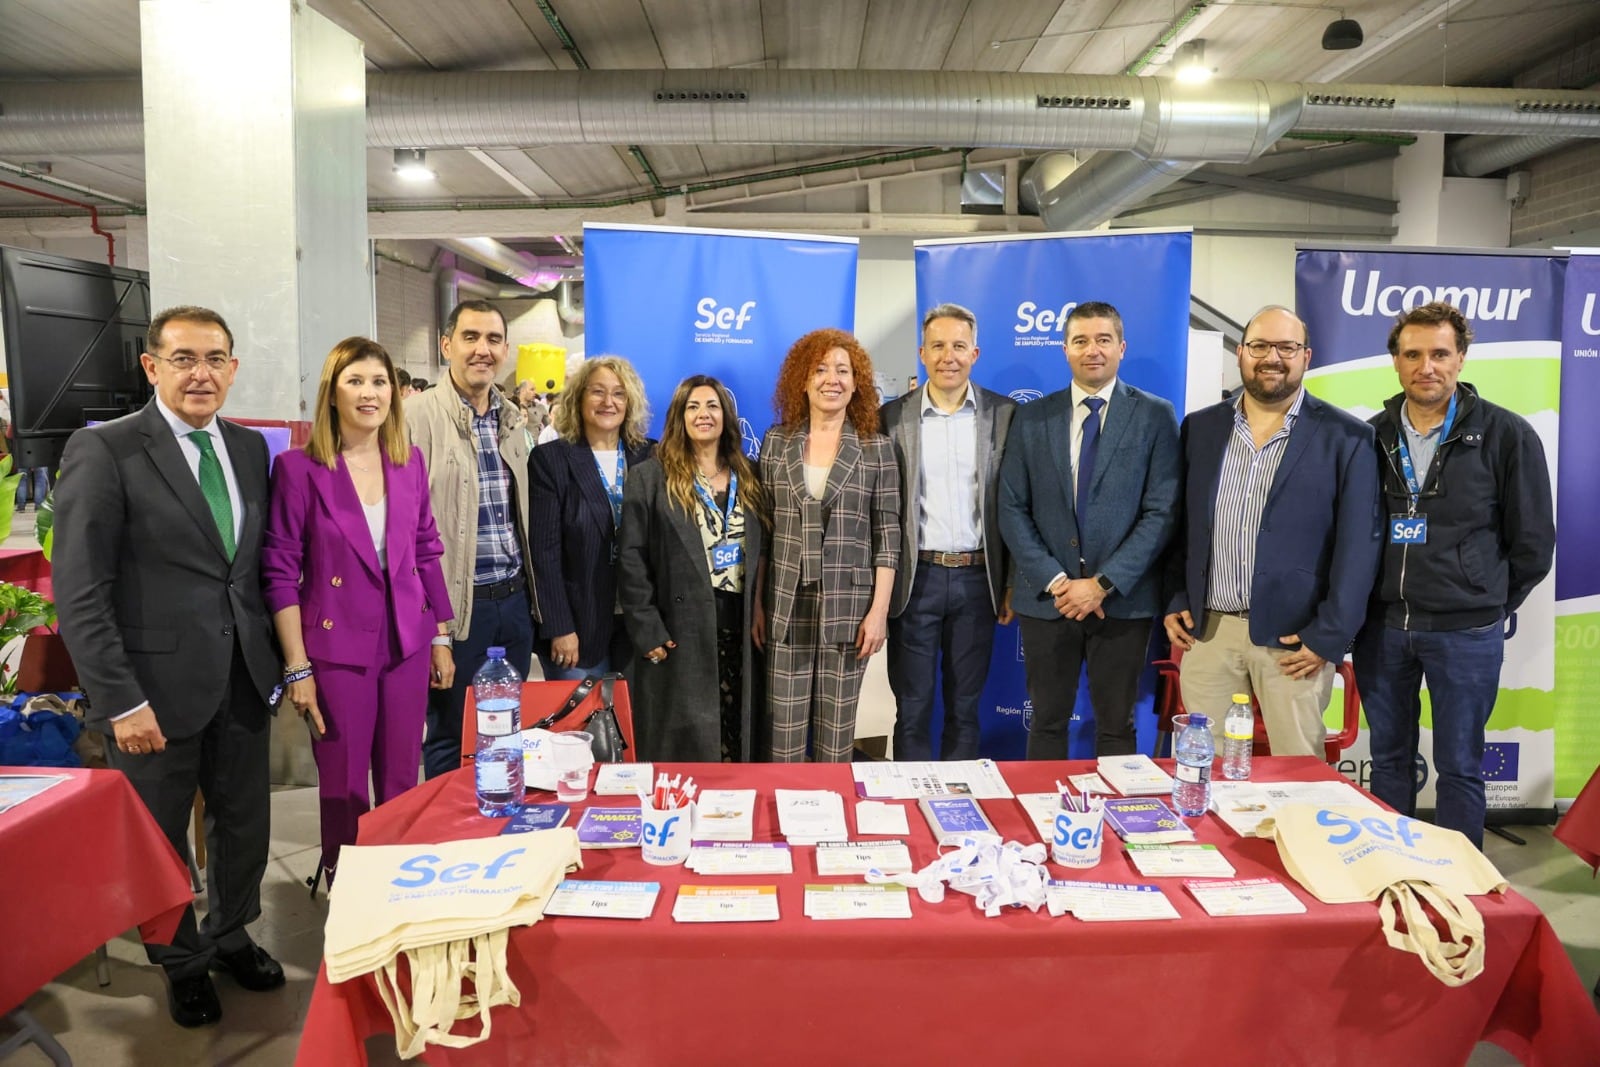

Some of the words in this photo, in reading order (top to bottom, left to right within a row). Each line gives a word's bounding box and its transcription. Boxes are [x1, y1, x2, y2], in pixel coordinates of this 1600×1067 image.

[1341, 269, 1532, 321] Ucomur
[694, 297, 756, 330] Sef
[1014, 301, 1077, 333] Sef
[1574, 348, 1598, 358] UNIÓN
[1393, 523, 1424, 539] Sef
[715, 550, 739, 565] Sef
[996, 706, 1021, 715] Región
[522, 739, 541, 749] Sef
[642, 816, 680, 847] ef
[1316, 809, 1423, 848] Sef
[856, 854, 872, 862] Tips
[391, 848, 527, 888] Sef
[591, 900, 608, 908] Tips
